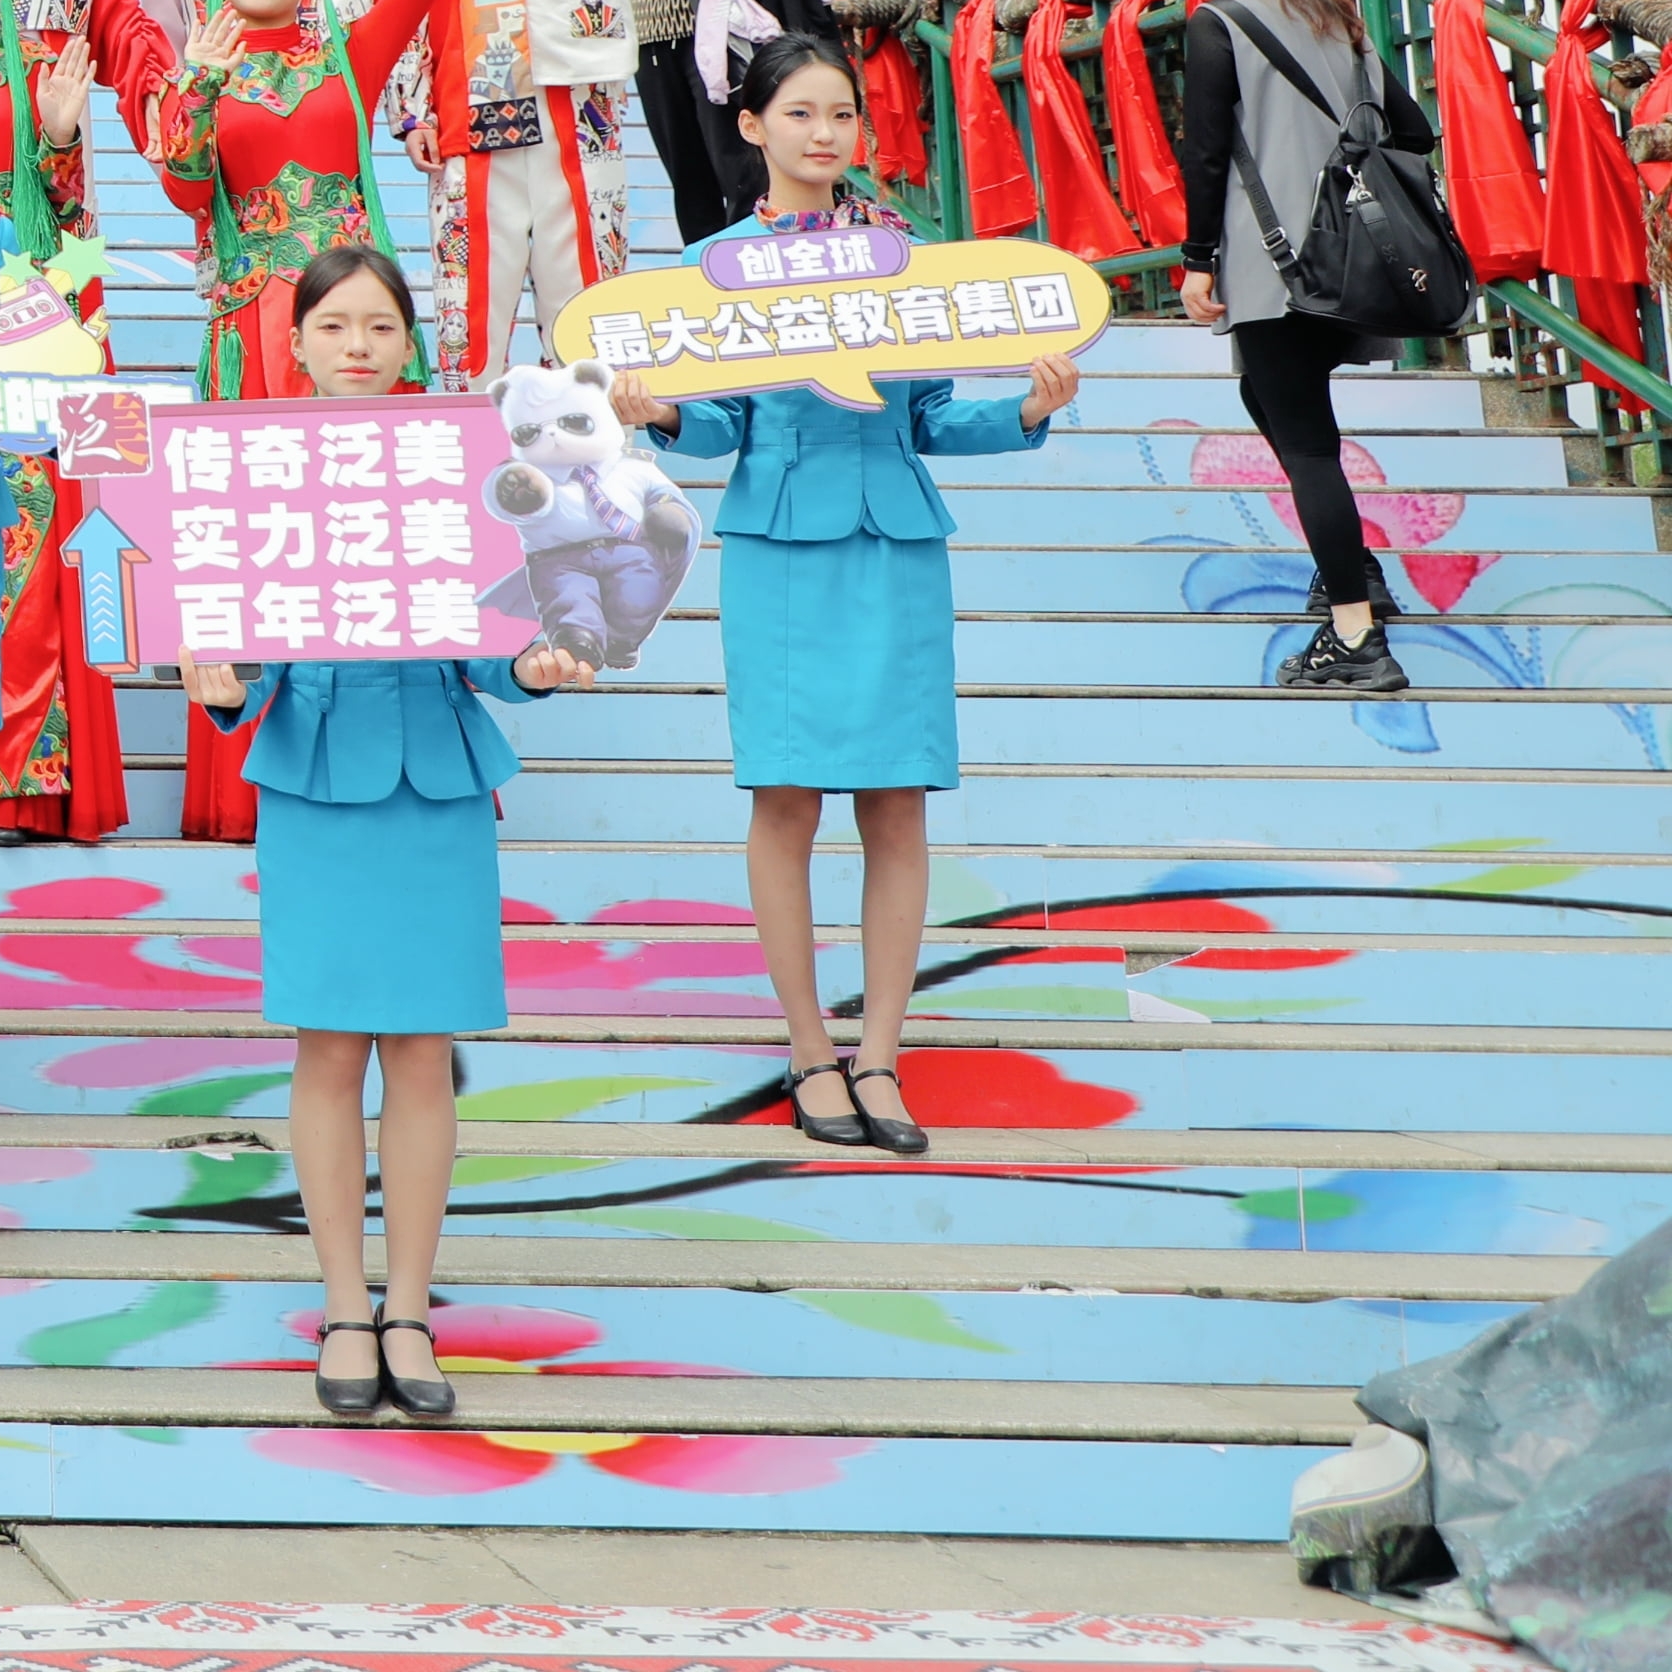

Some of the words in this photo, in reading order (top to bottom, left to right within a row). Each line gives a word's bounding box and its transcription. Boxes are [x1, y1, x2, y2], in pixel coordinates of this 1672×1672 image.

[736, 234, 876, 283] 创全球
[590, 274, 1080, 369] 最大公益教育集团
[164, 420, 467, 494] 传奇泛美
[171, 499, 474, 572] 实力泛美
[174, 578, 481, 652] 百年泛美
